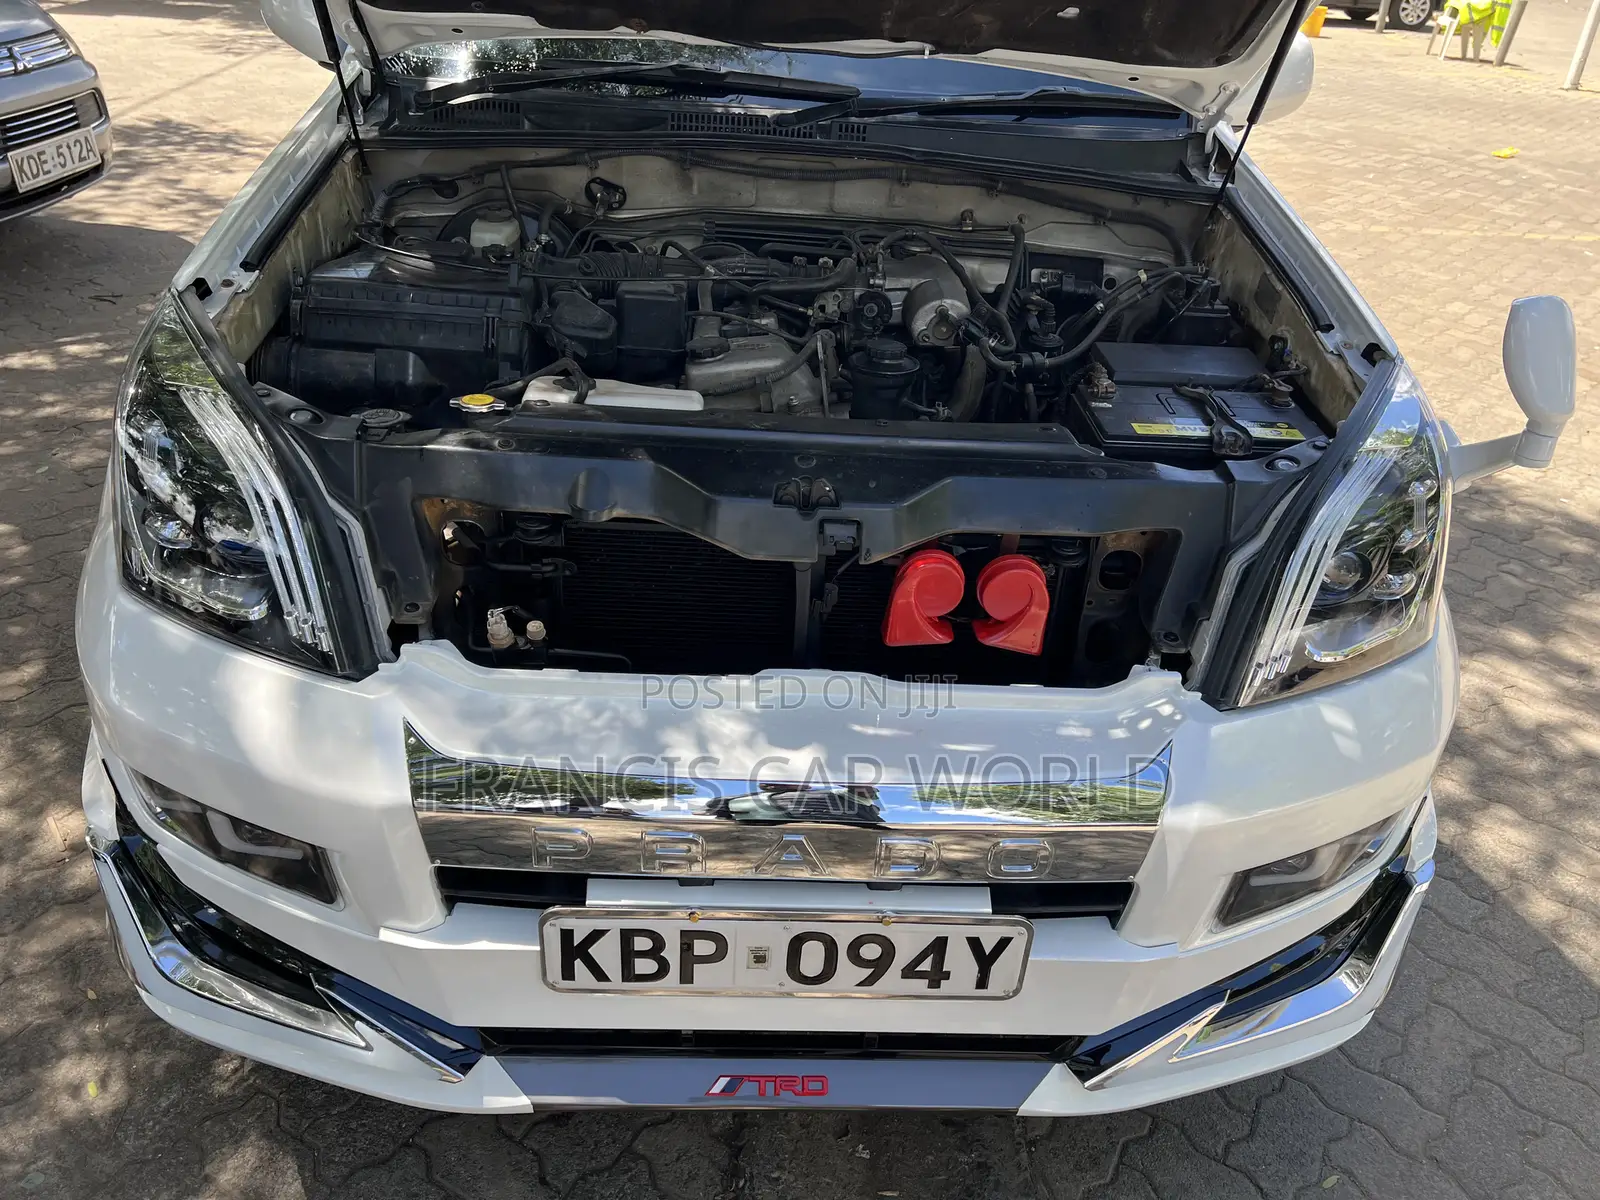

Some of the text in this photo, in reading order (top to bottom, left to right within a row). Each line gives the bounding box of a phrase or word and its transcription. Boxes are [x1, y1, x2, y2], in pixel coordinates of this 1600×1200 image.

[16, 136, 97, 184] KDE 512A
[531, 827, 1056, 878] PRADO
[561, 929, 1013, 990] KBP 094Y
[747, 1075, 829, 1096] TRD
